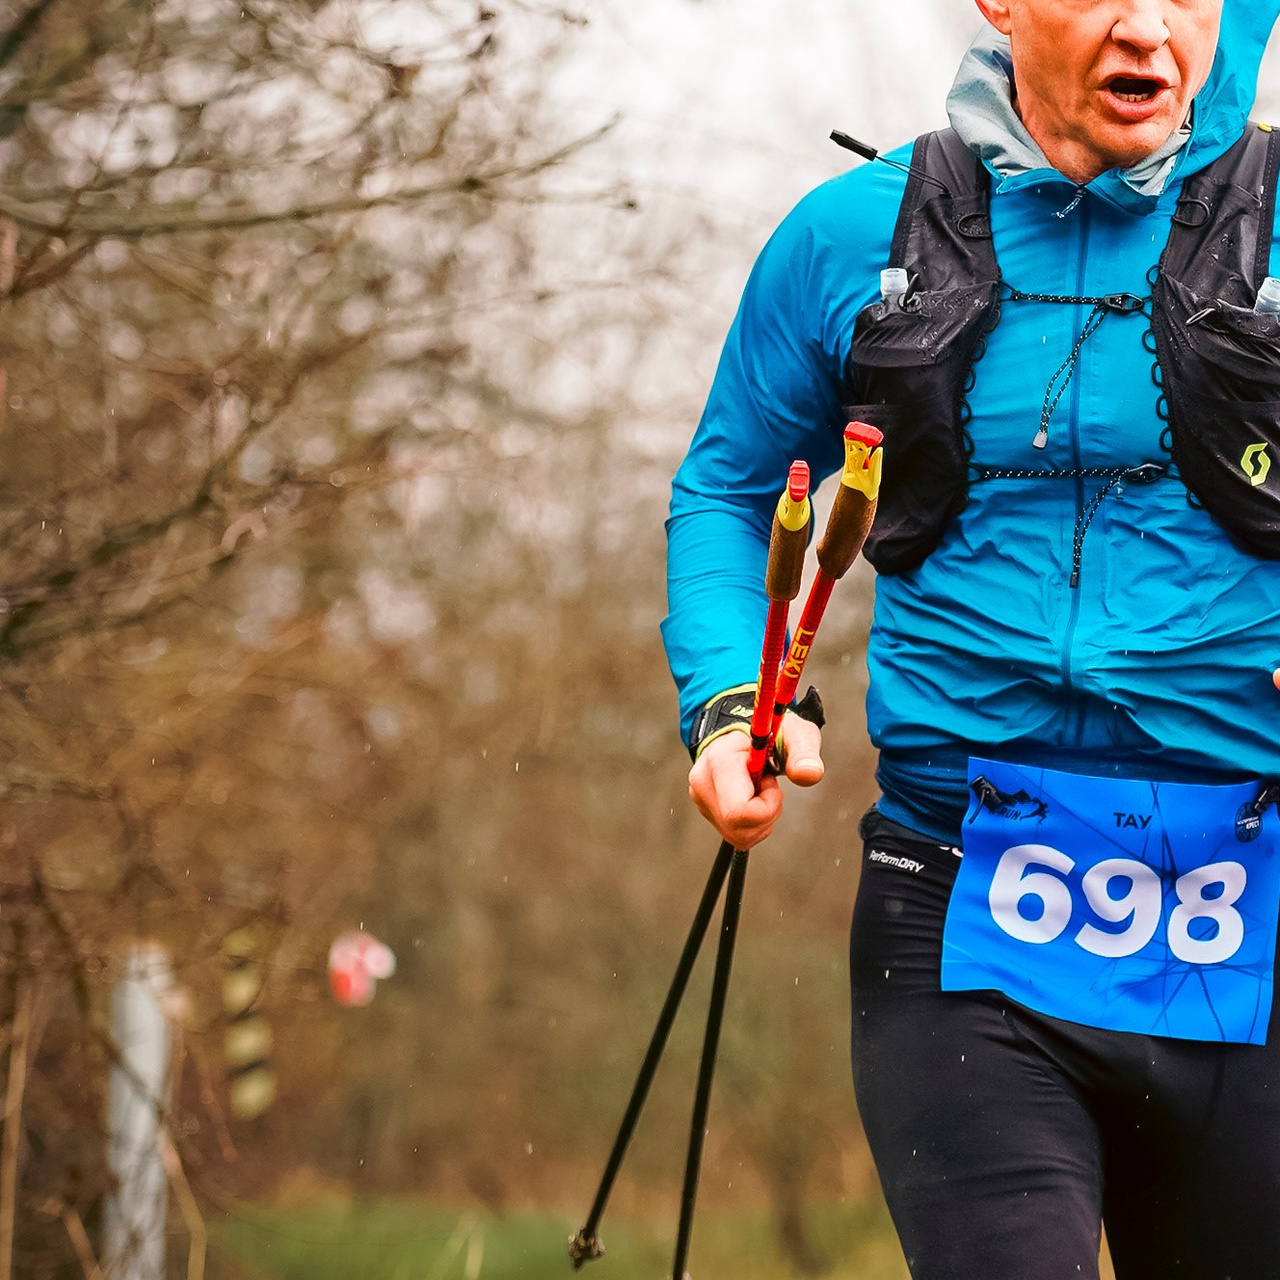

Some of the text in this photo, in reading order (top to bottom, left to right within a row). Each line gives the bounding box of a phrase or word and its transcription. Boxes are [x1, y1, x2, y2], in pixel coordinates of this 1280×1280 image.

[783, 626, 814, 678] LEKI
[1112, 812, 1153, 830] TAY
[989, 844, 1247, 965] 698
